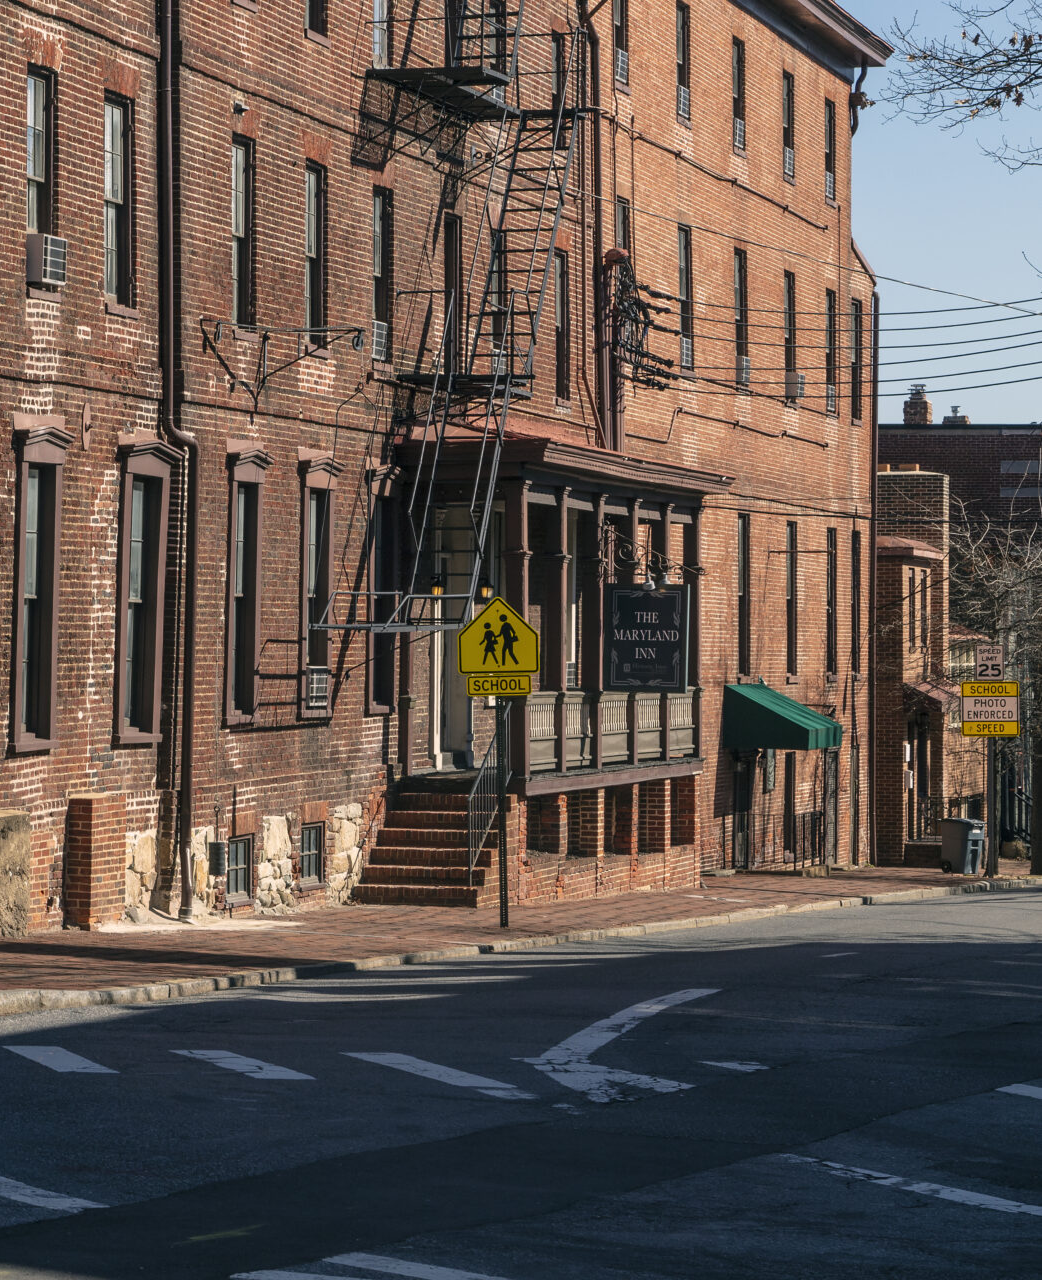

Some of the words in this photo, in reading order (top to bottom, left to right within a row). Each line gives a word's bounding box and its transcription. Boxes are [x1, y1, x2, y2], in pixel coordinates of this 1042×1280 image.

[634, 611, 659, 624] THE
[613, 628, 680, 642] MARYLAND
[634, 647, 657, 660] INN
[978, 664, 1001, 677] 25
[472, 679, 526, 692] SCHOOL
[970, 685, 1011, 695] SCHOOL
[973, 699, 1007, 708] PHOTO
[967, 710, 1014, 720] ENFORCED
[976, 724, 1005, 733] SPEED
